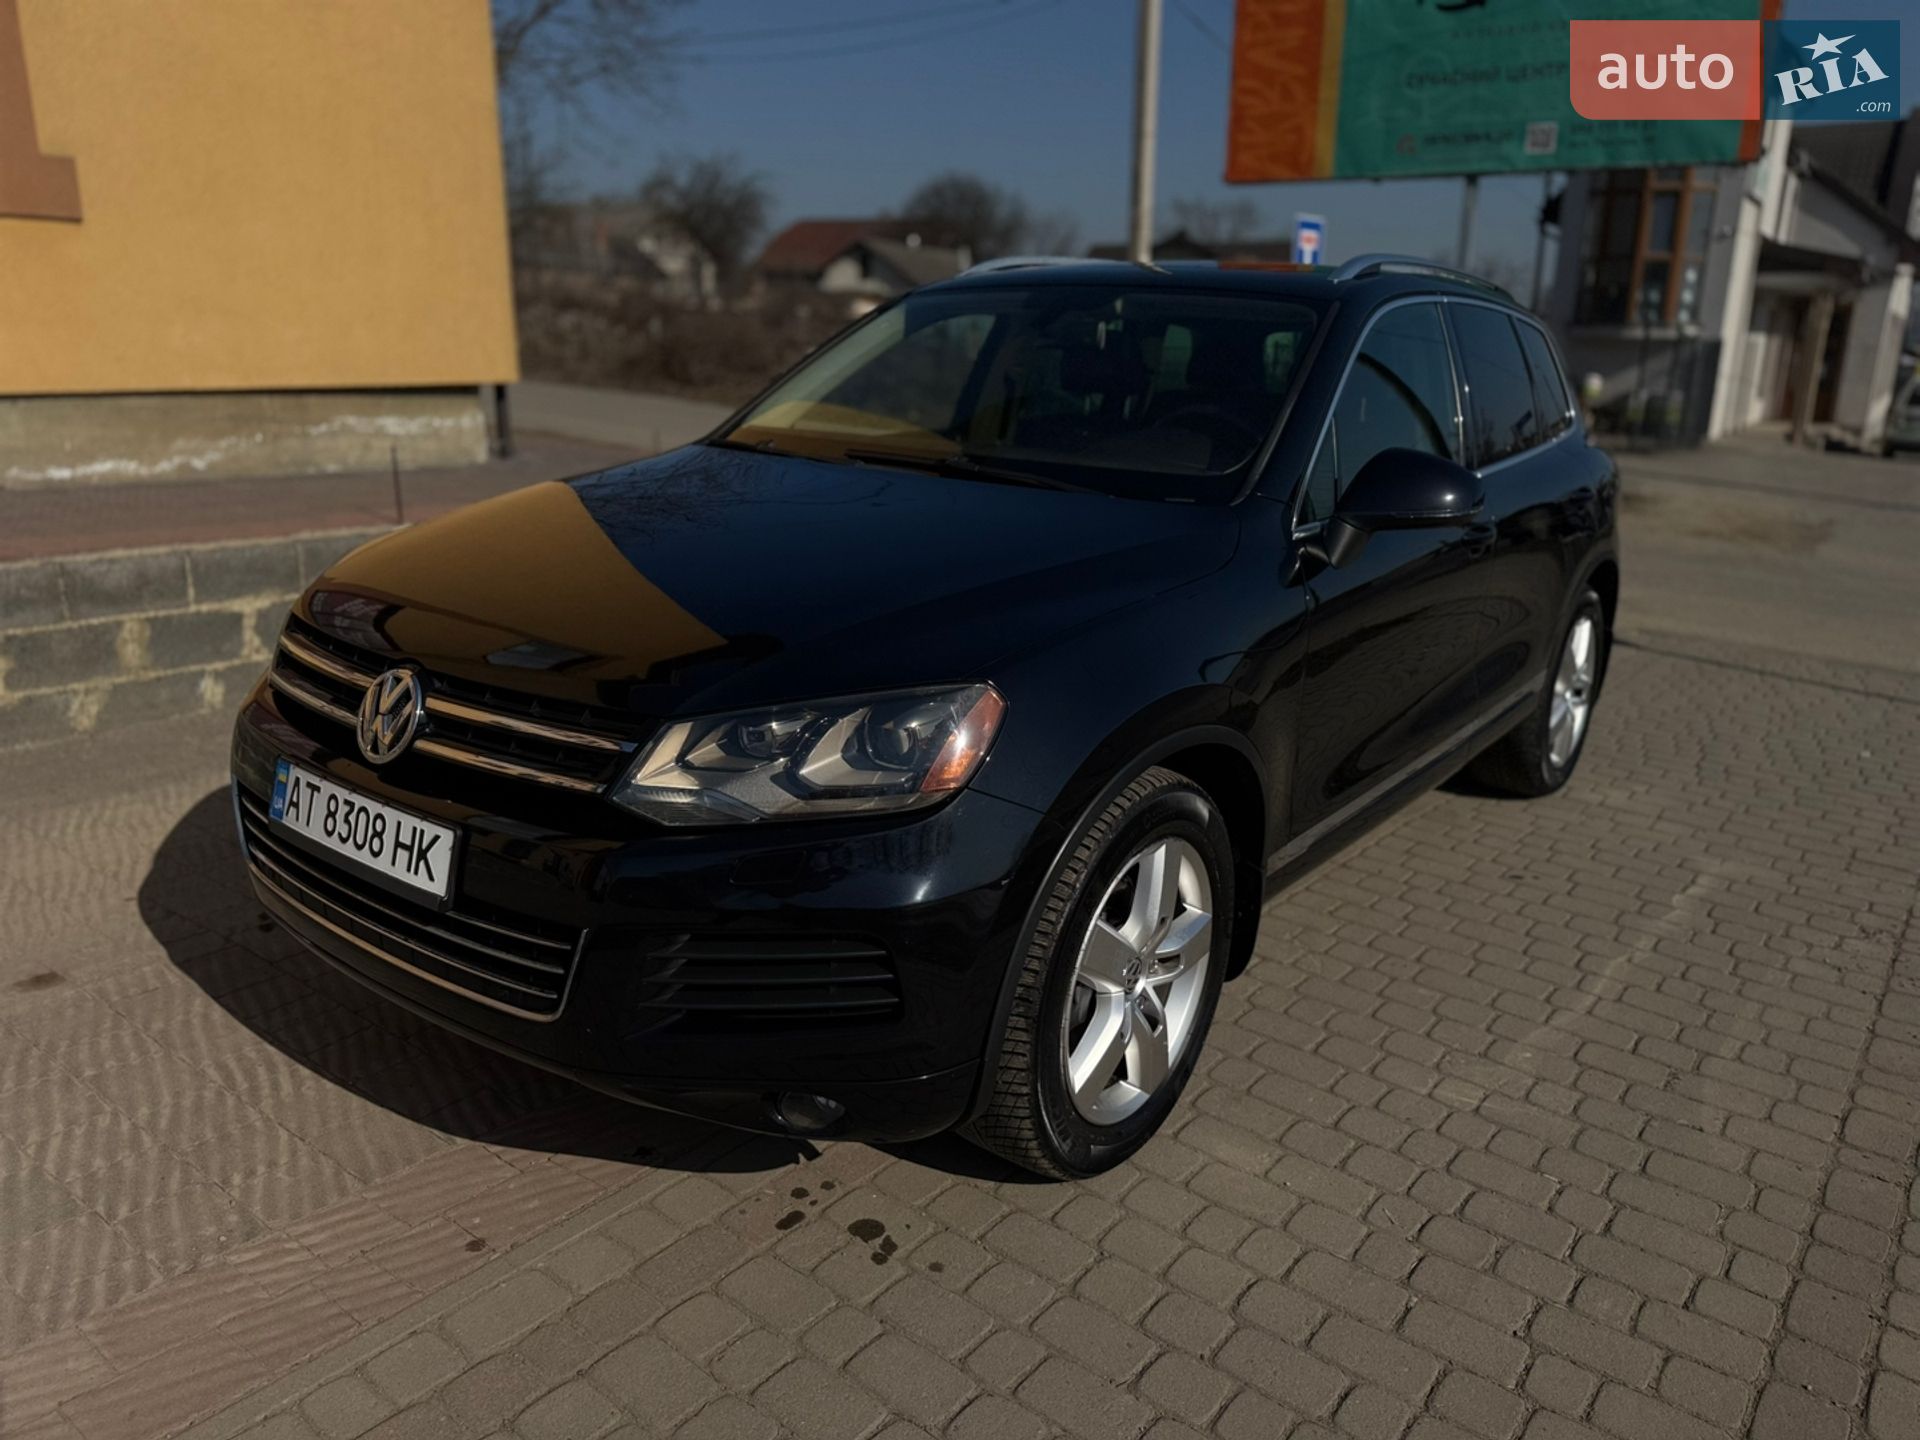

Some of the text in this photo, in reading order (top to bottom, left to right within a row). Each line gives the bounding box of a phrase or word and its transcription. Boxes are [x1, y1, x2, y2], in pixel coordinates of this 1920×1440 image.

[286, 776, 441, 883] AT 8308 HK
